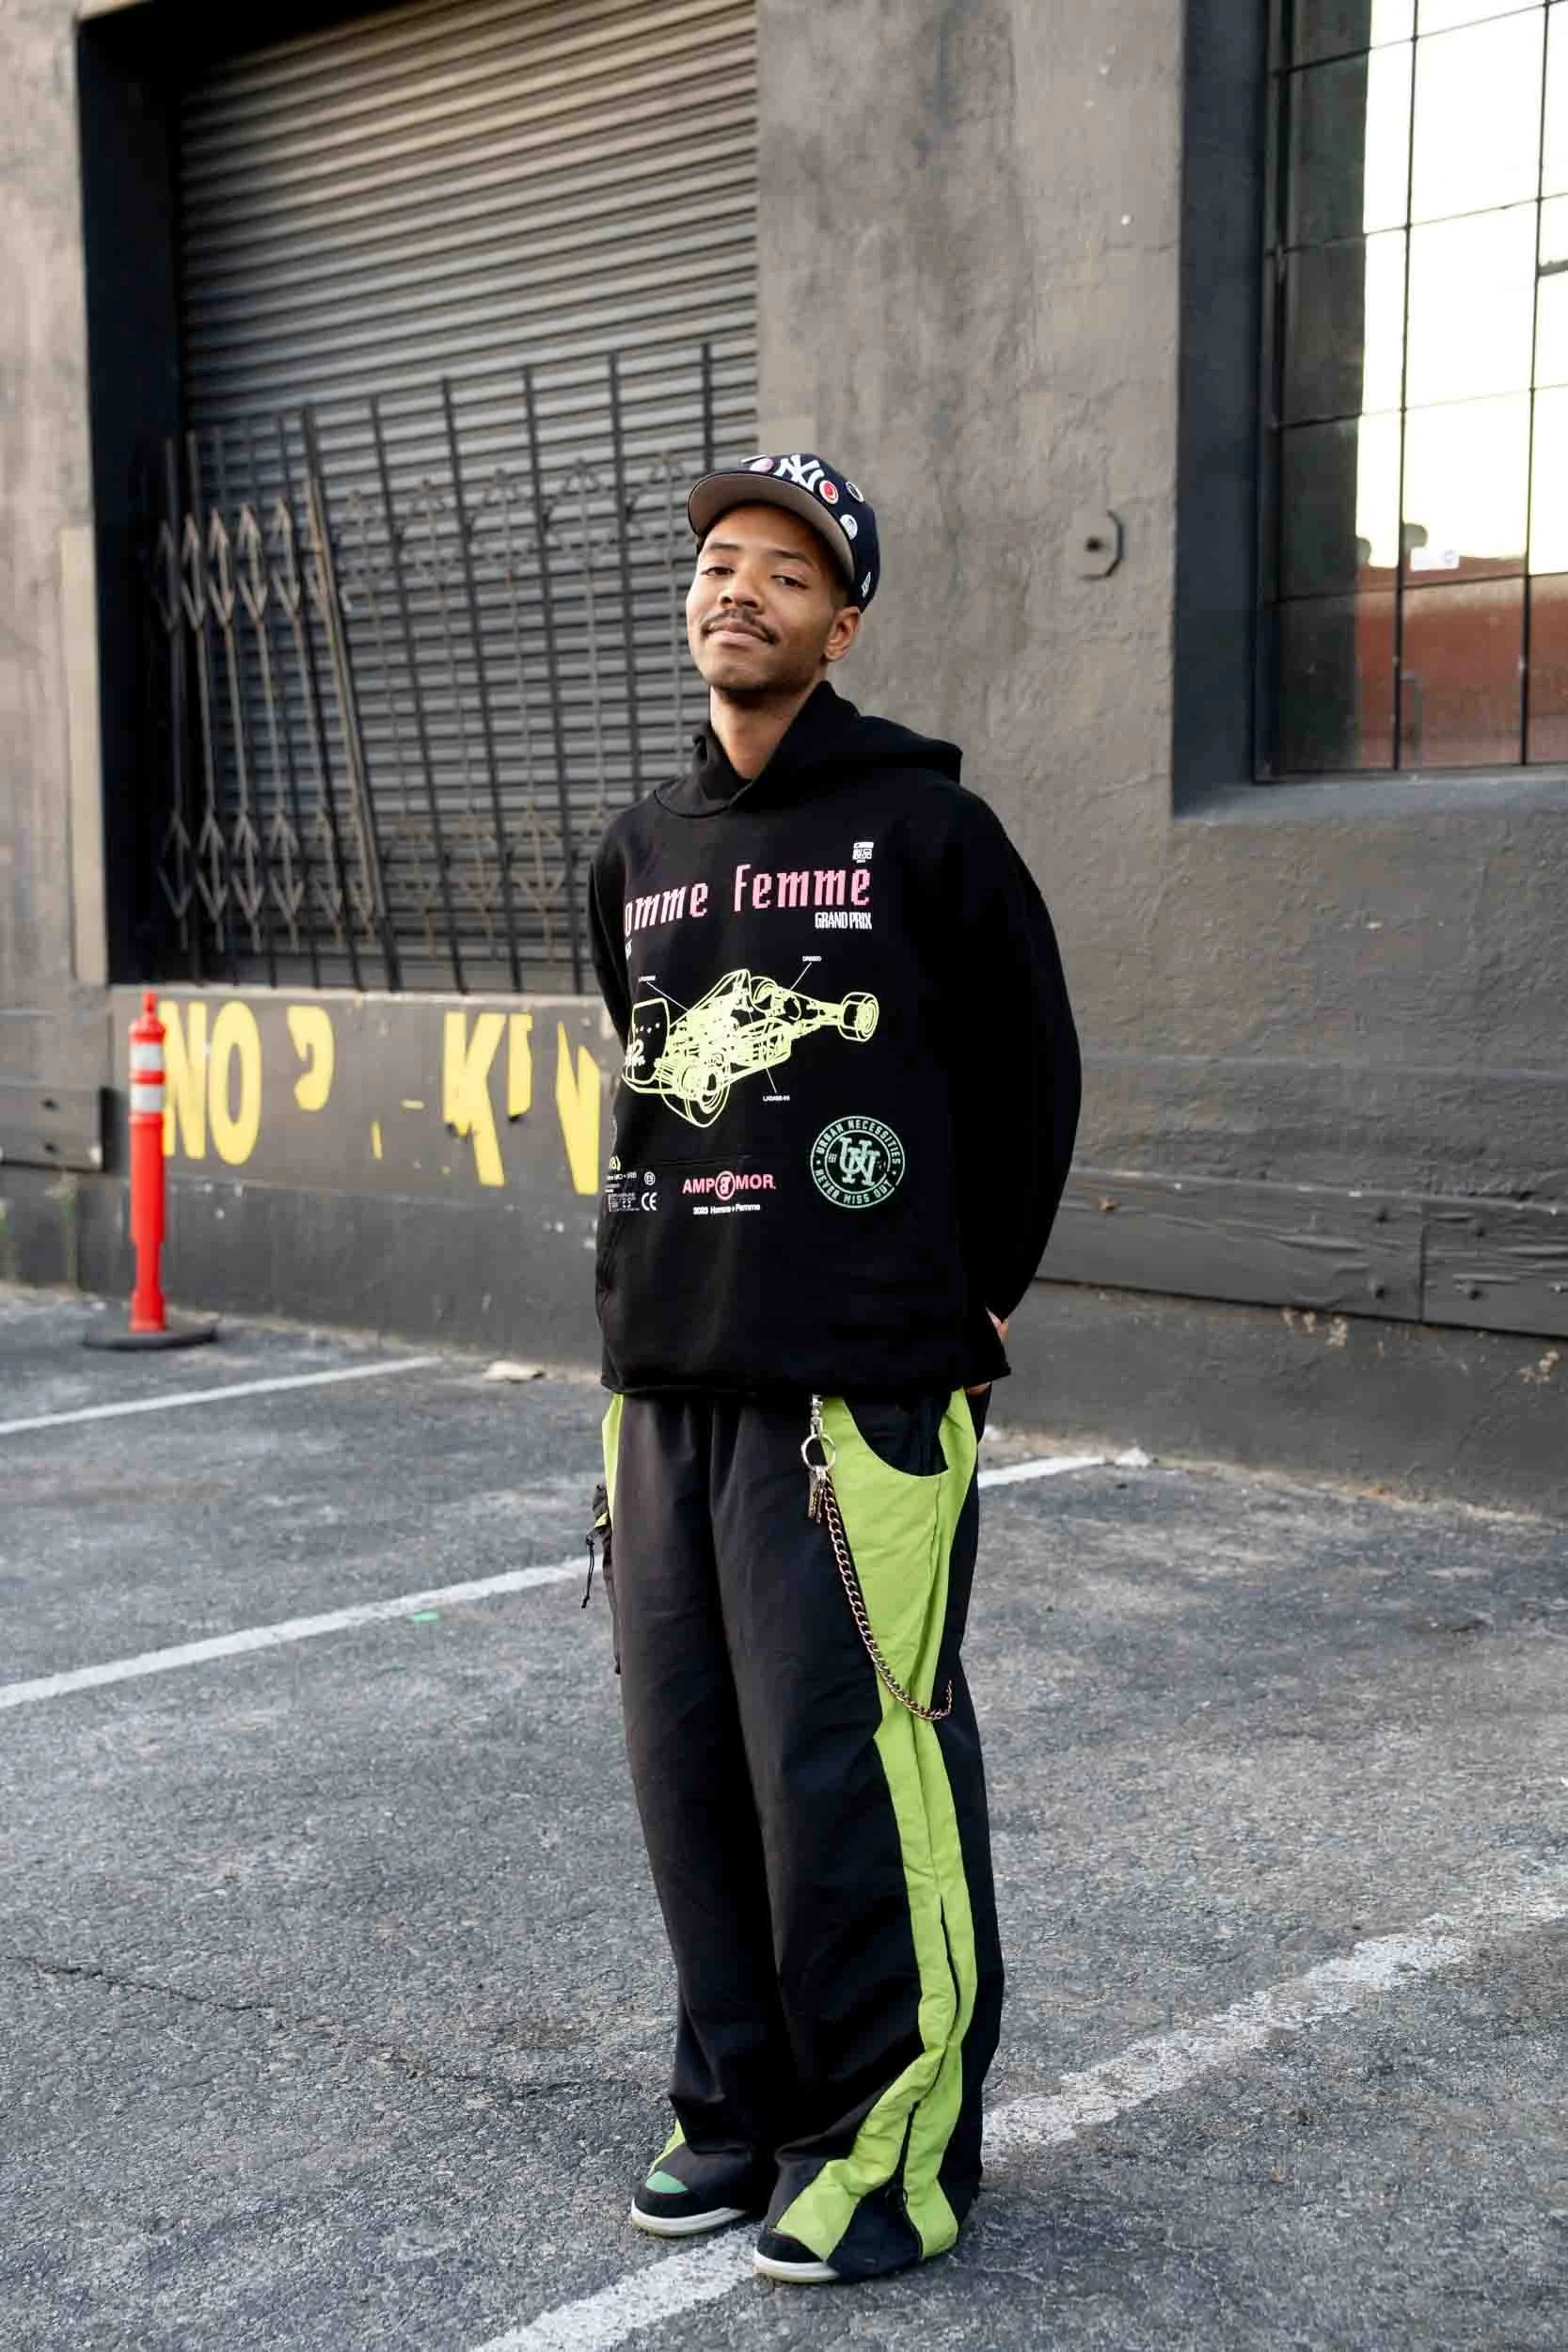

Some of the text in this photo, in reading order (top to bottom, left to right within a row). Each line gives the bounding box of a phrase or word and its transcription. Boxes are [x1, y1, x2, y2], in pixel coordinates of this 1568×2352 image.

[625, 864, 871, 937] omme Femme
[815, 912, 873, 930] GRAND PRIX
[158, 1000, 261, 1165] NO
[816, 1120, 901, 1165] URBAN NECESSITIES
[815, 1168, 893, 1204] NEVER MISS OUT
